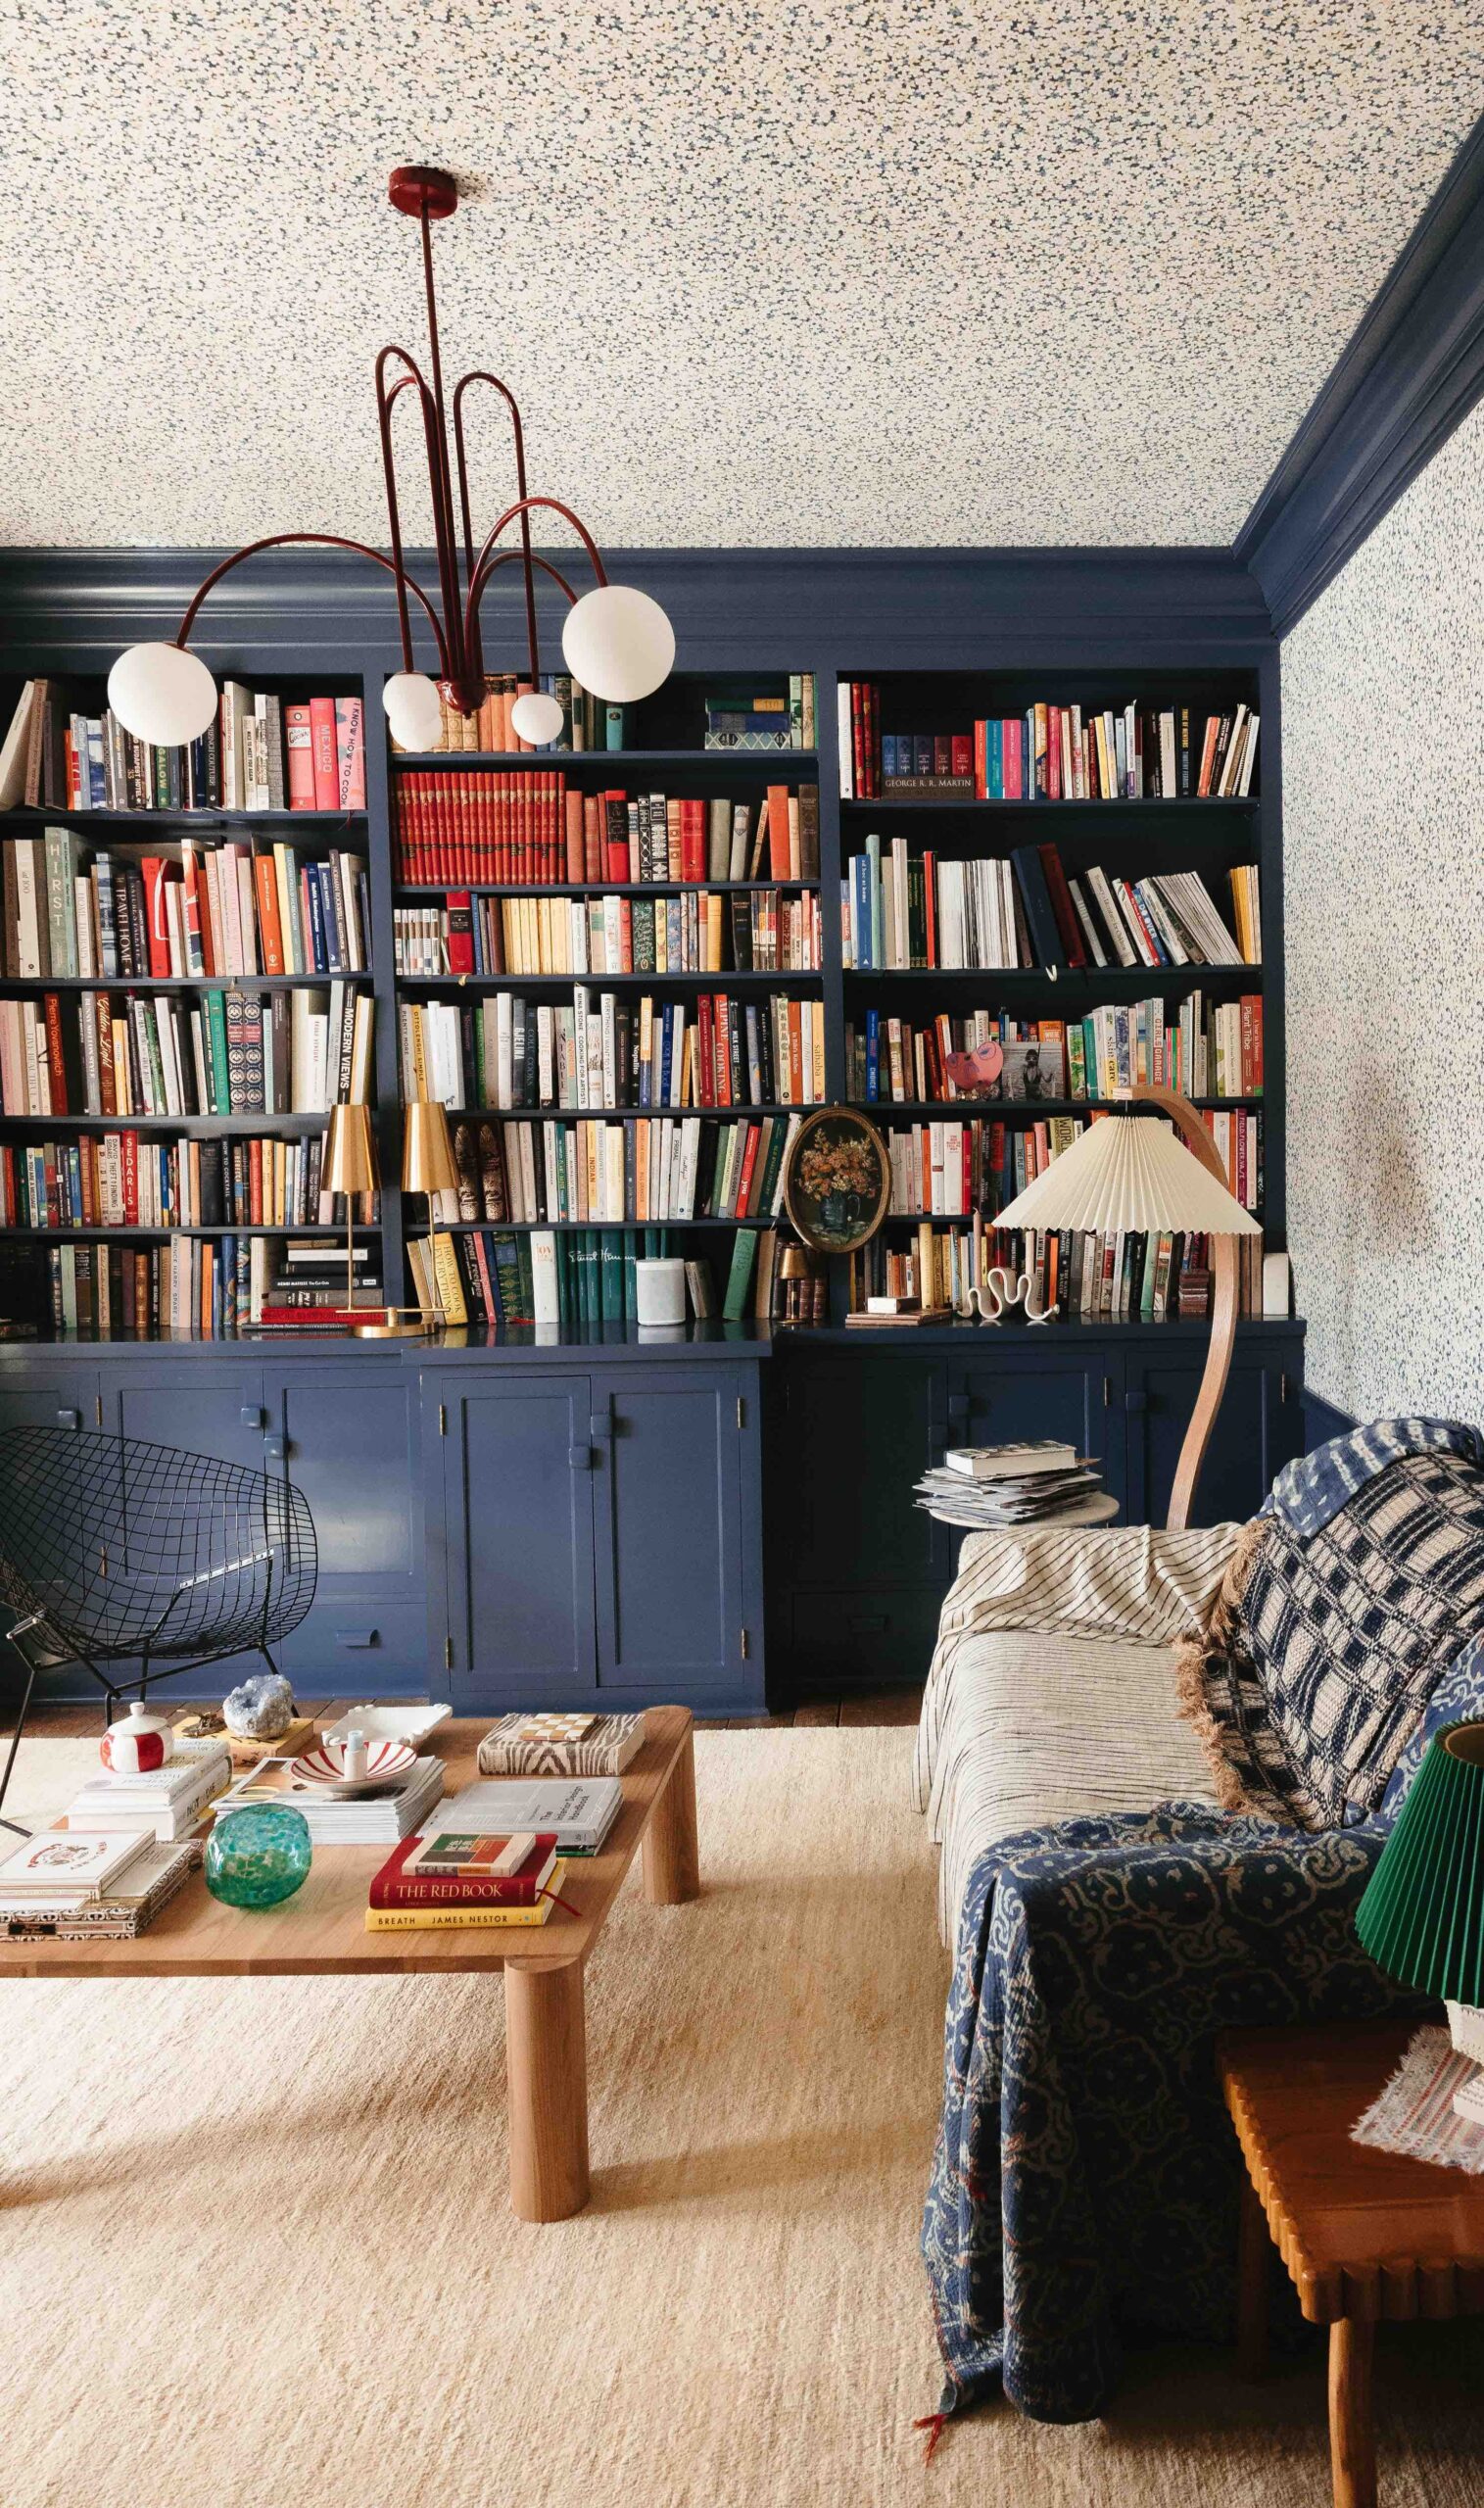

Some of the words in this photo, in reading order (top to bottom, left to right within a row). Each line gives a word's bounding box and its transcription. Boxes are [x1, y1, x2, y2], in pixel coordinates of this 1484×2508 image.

[349, 708, 359, 737] KNOW
[321, 724, 332, 773] MEXICO
[346, 739, 356, 761] HOW
[343, 764, 353, 777] TO
[340, 780, 350, 806] COOK
[119, 929, 131, 964] HOME
[49, 998, 58, 1025] Pierre
[96, 997, 110, 1033] Golden
[720, 999, 729, 1040] ALPINE
[343, 1007, 354, 1053] MODERN
[413, 1011, 422, 1055] OTTOLENGHI
[513, 1027, 525, 1060] GJELINA
[50, 1025, 62, 1076] Yovanovitch
[99, 1034, 113, 1068] Light
[814, 1044, 824, 1077] sababa
[1107, 1037, 1116, 1058] skin
[340, 1055, 351, 1089] VIEWS
[716, 1042, 727, 1093] COOKING
[443, 1245, 455, 1268] HOW
[463, 1233, 477, 1260] great
[471, 1263, 483, 1298] recipes
[448, 1272, 456, 1284] TO
[451, 1286, 461, 1314] COOK
[539, 1810, 553, 1821] The
[397, 1885, 428, 1898] THE
[432, 1884, 459, 1898] RED
[462, 1884, 503, 1898] BOOK
